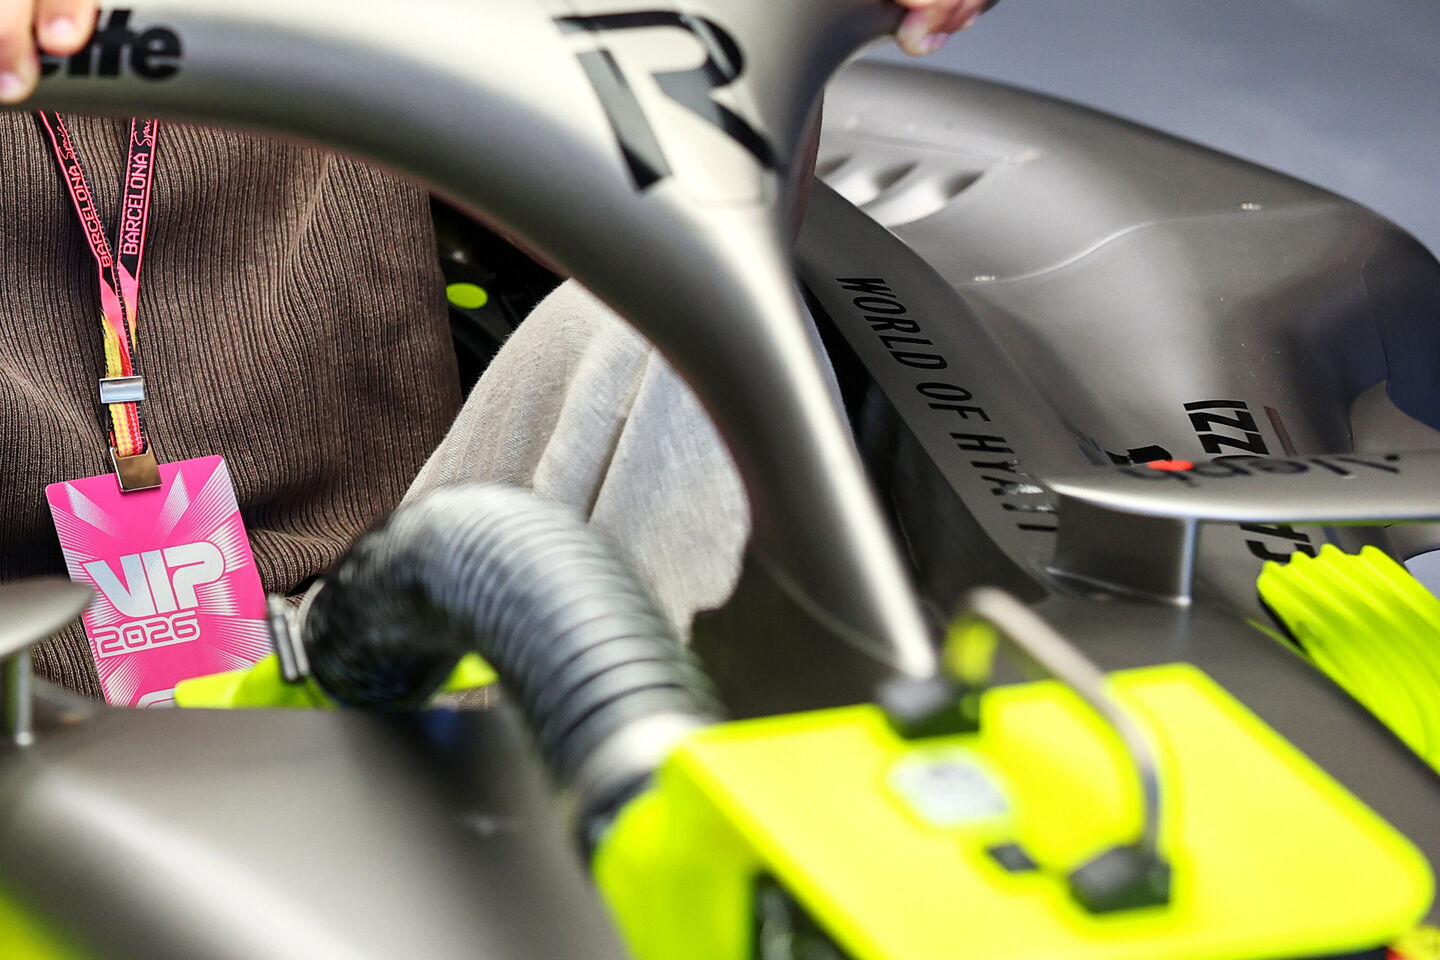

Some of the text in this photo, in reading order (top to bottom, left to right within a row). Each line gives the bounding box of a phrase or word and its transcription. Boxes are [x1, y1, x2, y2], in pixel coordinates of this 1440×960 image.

[552, 10, 786, 192] R
[68, 165, 112, 268] BARCELONA
[123, 119, 154, 255] BARCELONA Spai
[835, 275, 949, 371] WORLD
[916, 381, 991, 423] OF
[81, 541, 225, 619] VIP
[92, 611, 201, 659] 2026
